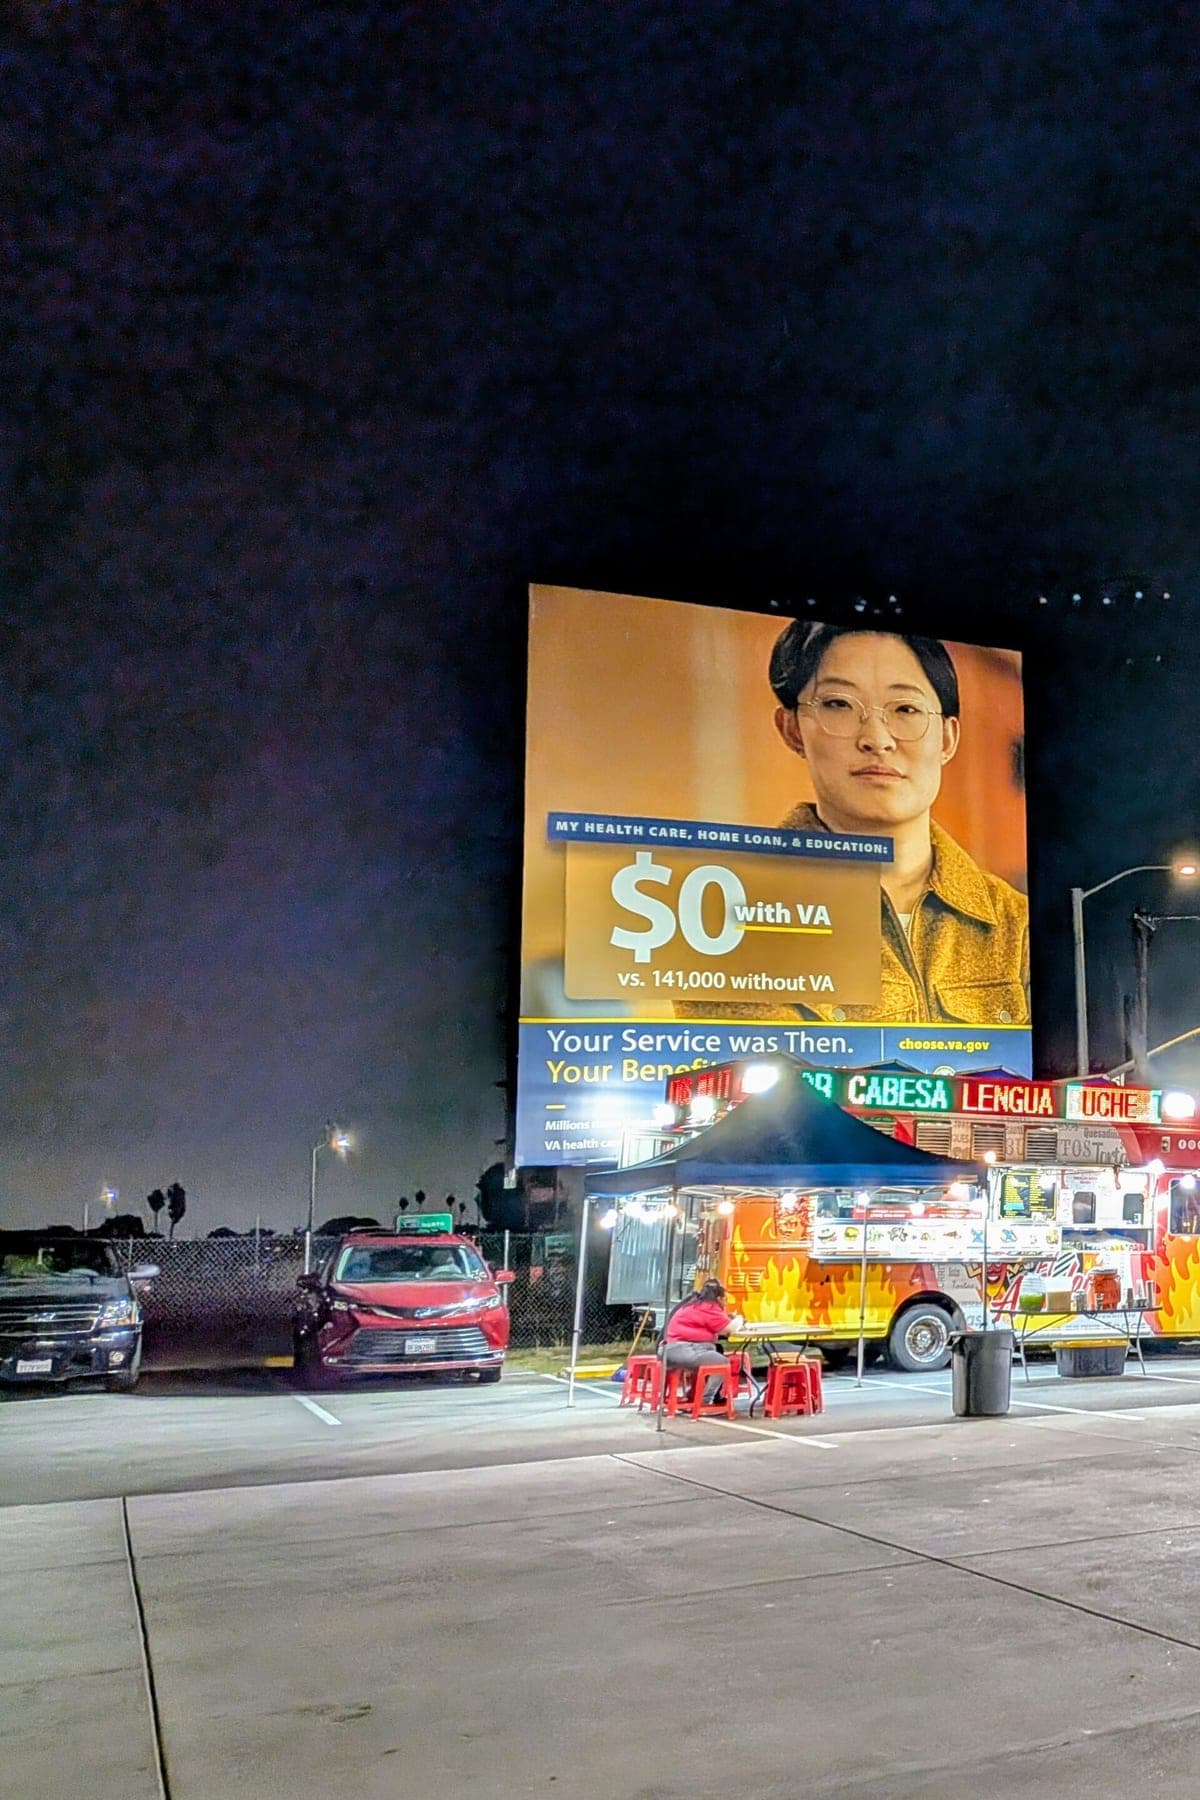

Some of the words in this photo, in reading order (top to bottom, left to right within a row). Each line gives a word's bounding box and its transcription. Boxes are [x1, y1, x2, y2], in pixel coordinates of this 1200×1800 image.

[555, 821, 579, 831] MY
[584, 822, 644, 836] HEALTH
[649, 827, 693, 840] CARE,
[697, 829, 740, 842] HOME
[744, 833, 787, 847] LOAN,
[791, 838, 802, 847] &
[805, 838, 888, 854] EDUCATION:
[610, 851, 747, 963] $0
[734, 901, 791, 924] with
[796, 904, 832, 926] VA
[617, 972, 646, 987] vs.
[651, 970, 726, 990] 141,000
[731, 973, 805, 991] without
[809, 974, 835, 992] VA
[546, 1030, 614, 1053] Your
[621, 1029, 721, 1053] Service
[729, 1034, 779, 1053] was
[784, 1031, 855, 1054] Then.
[899, 1037, 990, 1053] choose.va.gov
[546, 1060, 612, 1083] Your
[847, 1074, 949, 1110] CABESA
[961, 1082, 1054, 1115] LENGUA
[544, 1120, 590, 1131] Millions
[544, 1140, 561, 1151] VA
[563, 1139, 599, 1150] health
